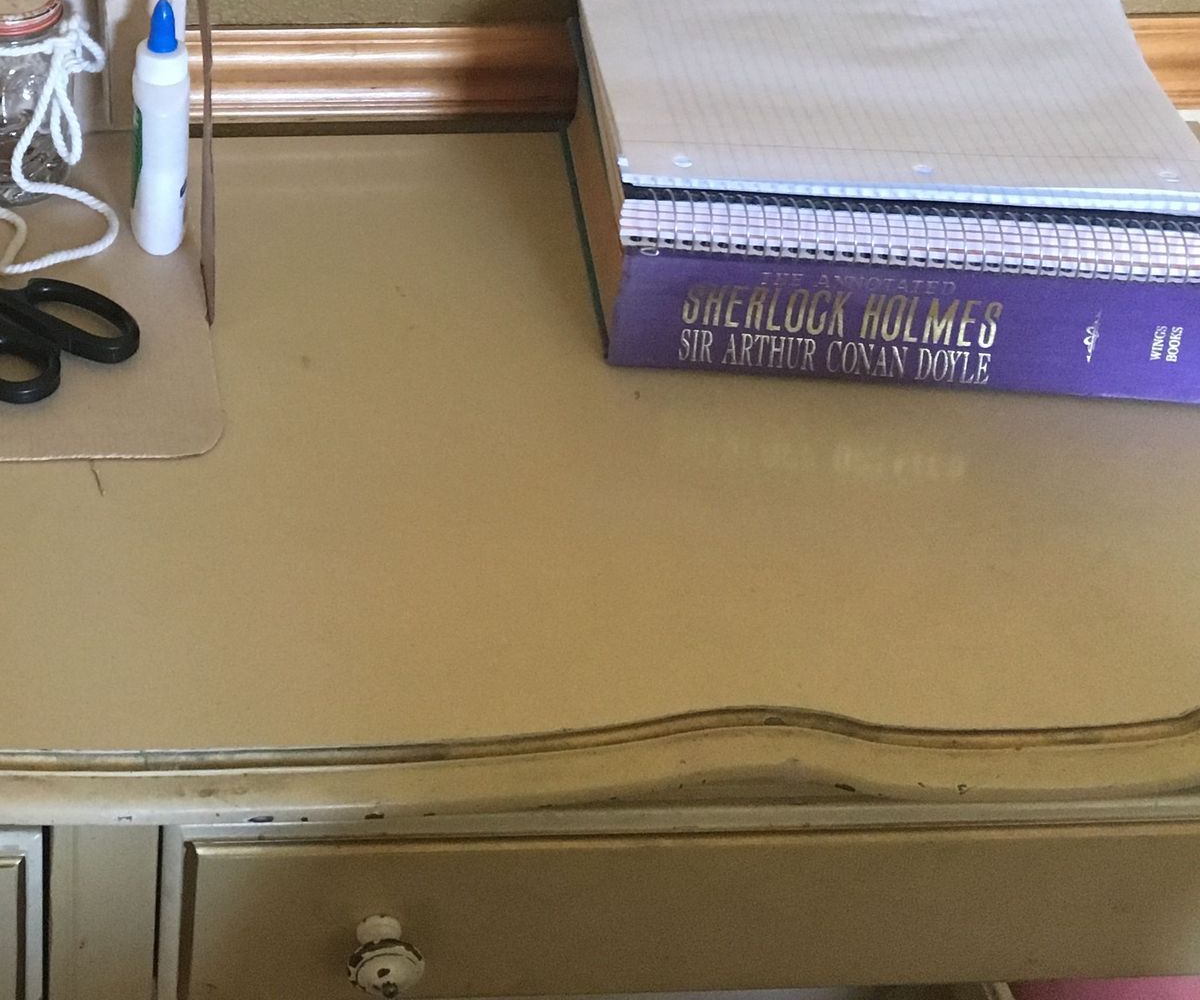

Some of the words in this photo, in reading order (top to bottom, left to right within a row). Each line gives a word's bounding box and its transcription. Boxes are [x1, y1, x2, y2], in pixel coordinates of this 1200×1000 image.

[681, 284, 852, 338] SHERLOCK
[859, 292, 1004, 349] HOLMES
[678, 328, 714, 364] SIR
[721, 333, 818, 372] ARTHUR
[826, 340, 909, 379] CONAN
[914, 347, 992, 385] DOYLE
[1149, 325, 1168, 361] WINGS
[1165, 326, 1184, 363] BOOKS
